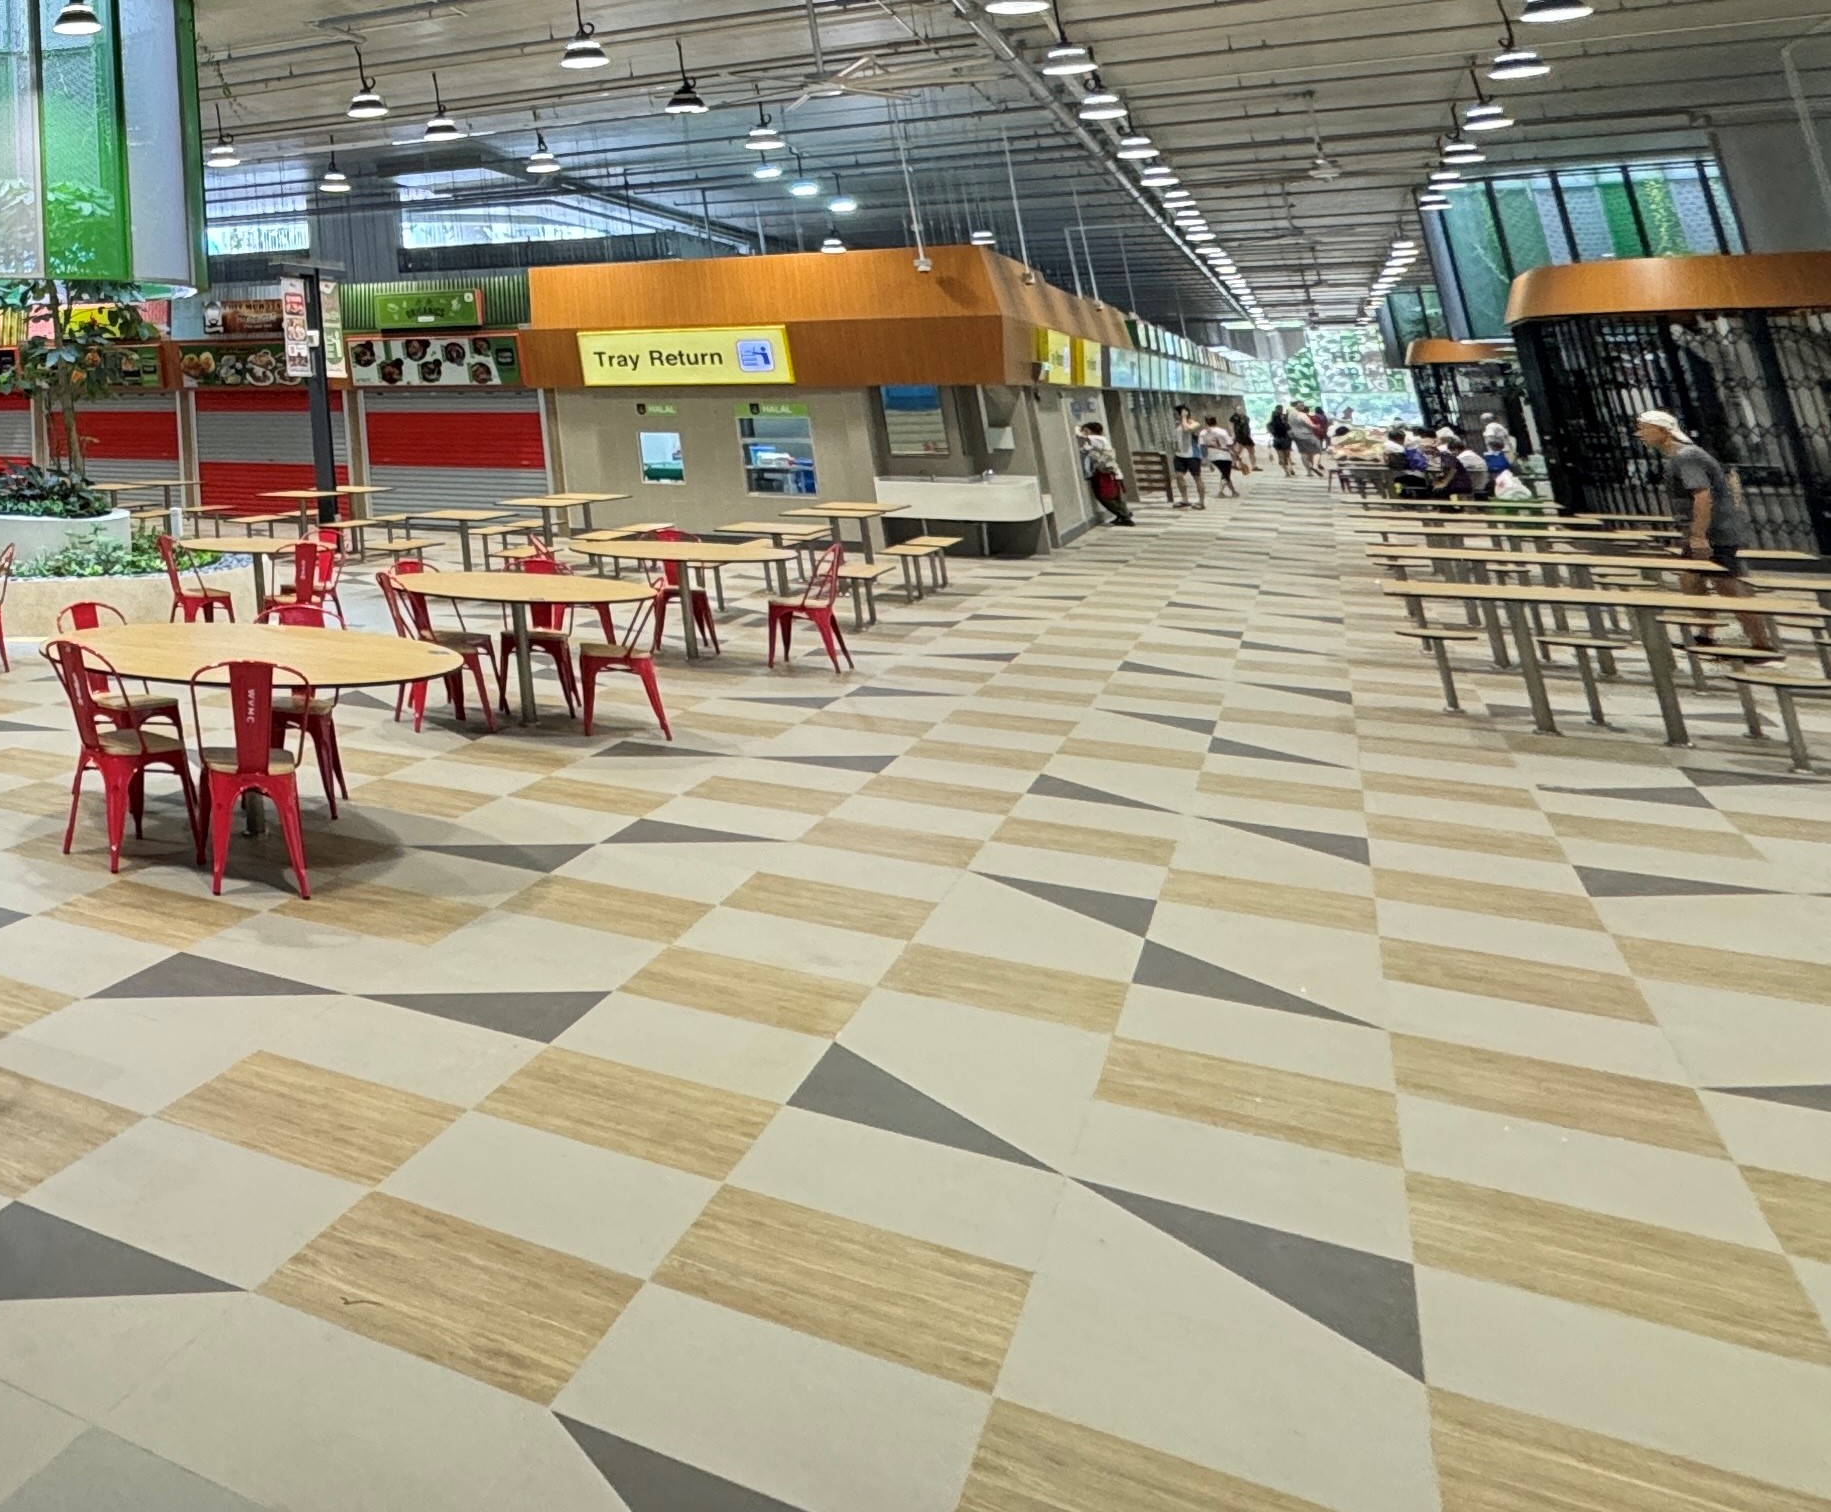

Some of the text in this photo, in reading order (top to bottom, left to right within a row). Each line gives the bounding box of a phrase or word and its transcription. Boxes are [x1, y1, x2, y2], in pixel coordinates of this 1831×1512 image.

[593, 349, 724, 371] Tray Return
[247, 688, 257, 724] WVHC
